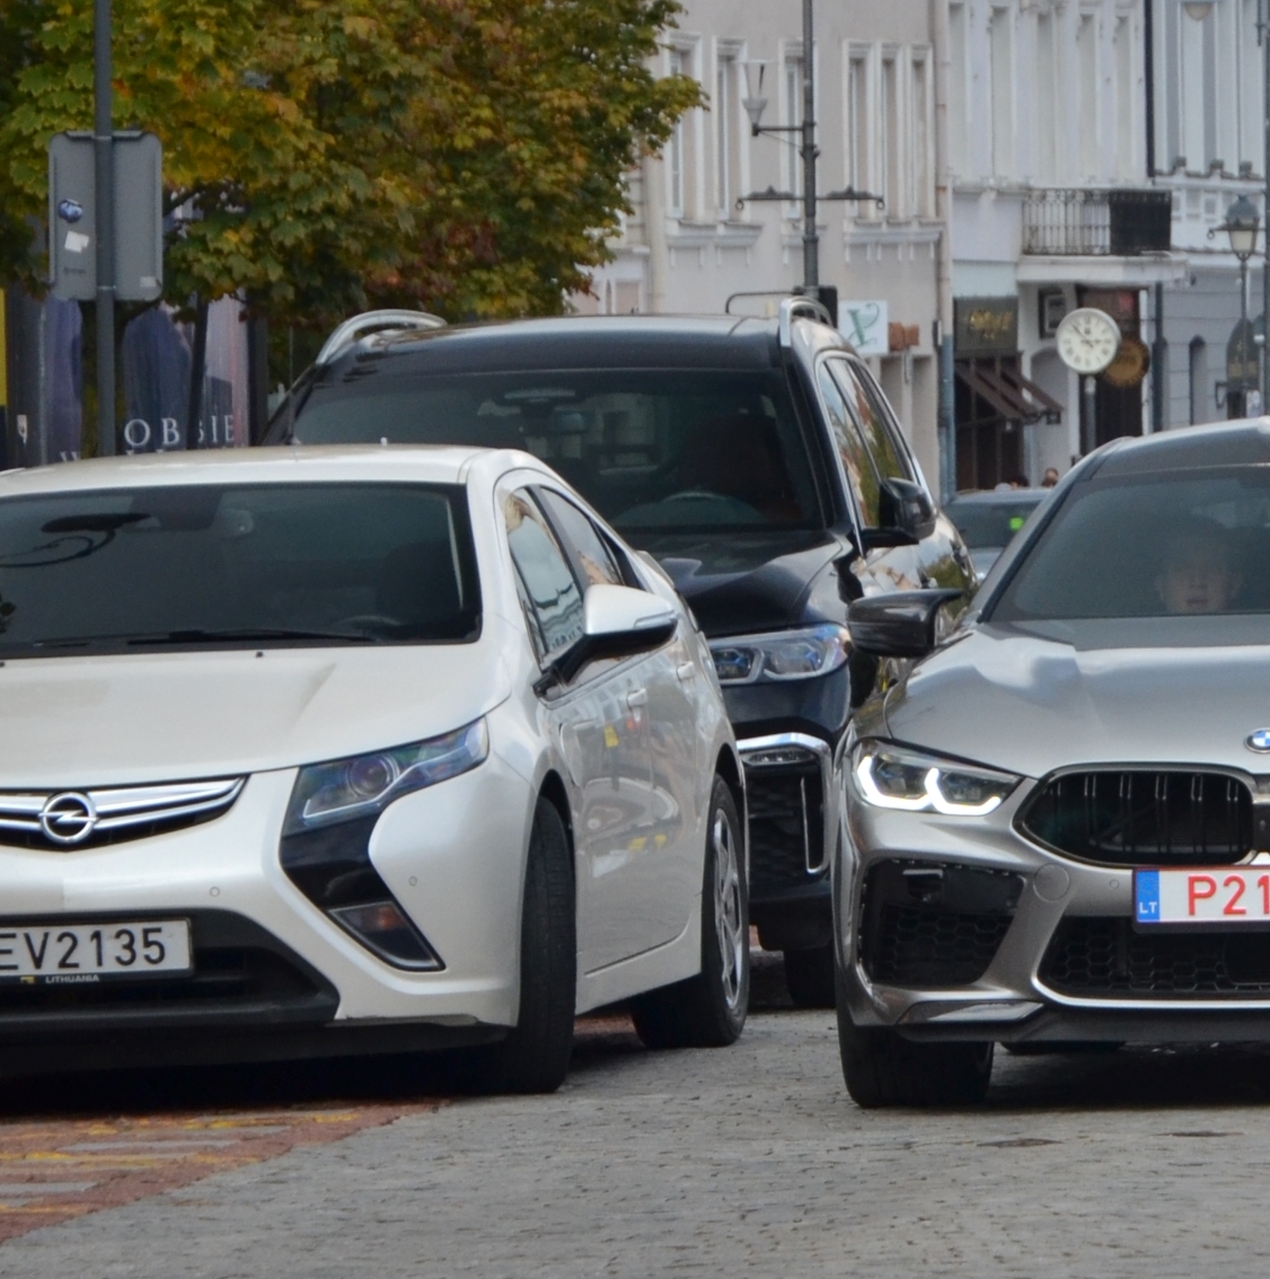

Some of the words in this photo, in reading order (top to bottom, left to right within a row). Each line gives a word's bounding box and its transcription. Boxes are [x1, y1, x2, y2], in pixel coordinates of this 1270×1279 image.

[1139, 902, 1158, 914] LT
[0, 927, 166, 970] EV2135
[45, 974, 100, 984] LITHUANIA
